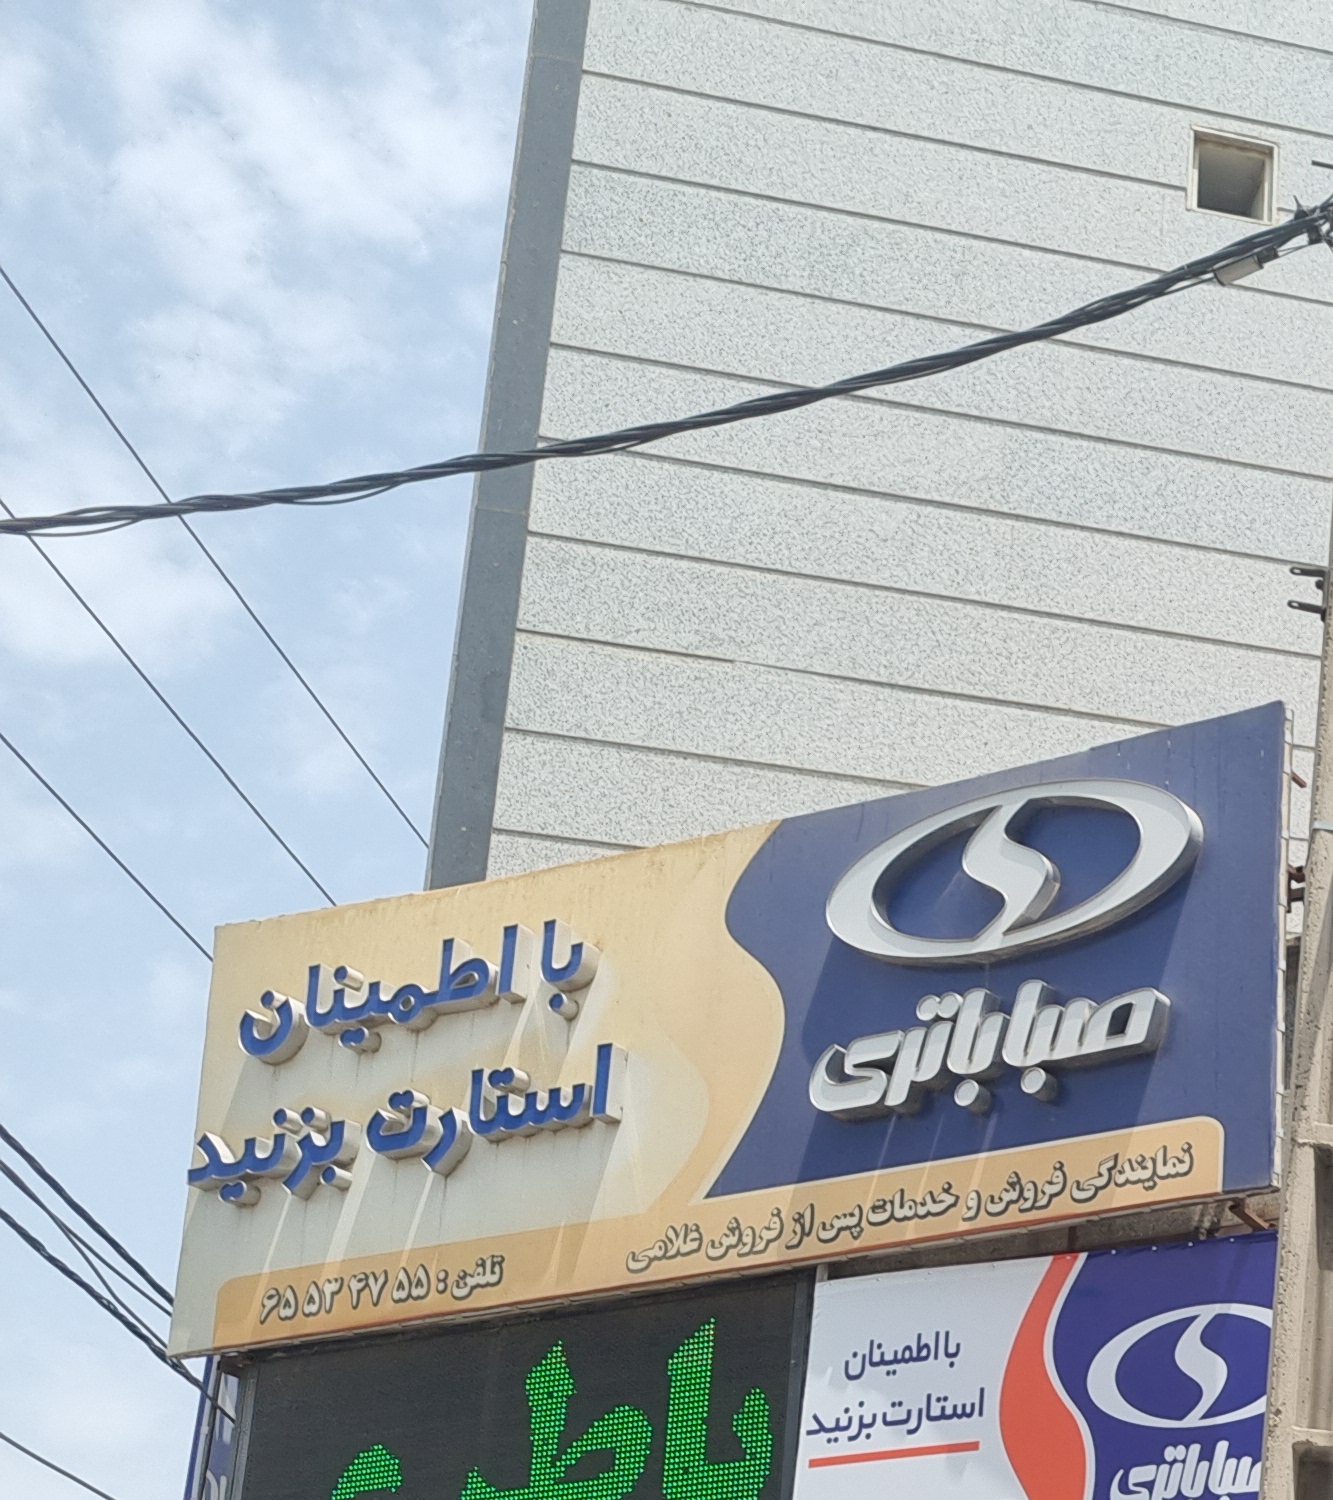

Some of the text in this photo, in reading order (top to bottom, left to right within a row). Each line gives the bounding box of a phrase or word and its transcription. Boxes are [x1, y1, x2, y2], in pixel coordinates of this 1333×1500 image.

[239, 919, 600, 1063] با اطمینان
[188, 1043, 622, 1203] استارت بزنید
[625, 1142, 1195, 1274] نمایندگی فروش و خدمات پس از فروش غلامی
[806, 1387, 985, 1446] استارت بزنید
[844, 1330, 961, 1381] با اطمینان
